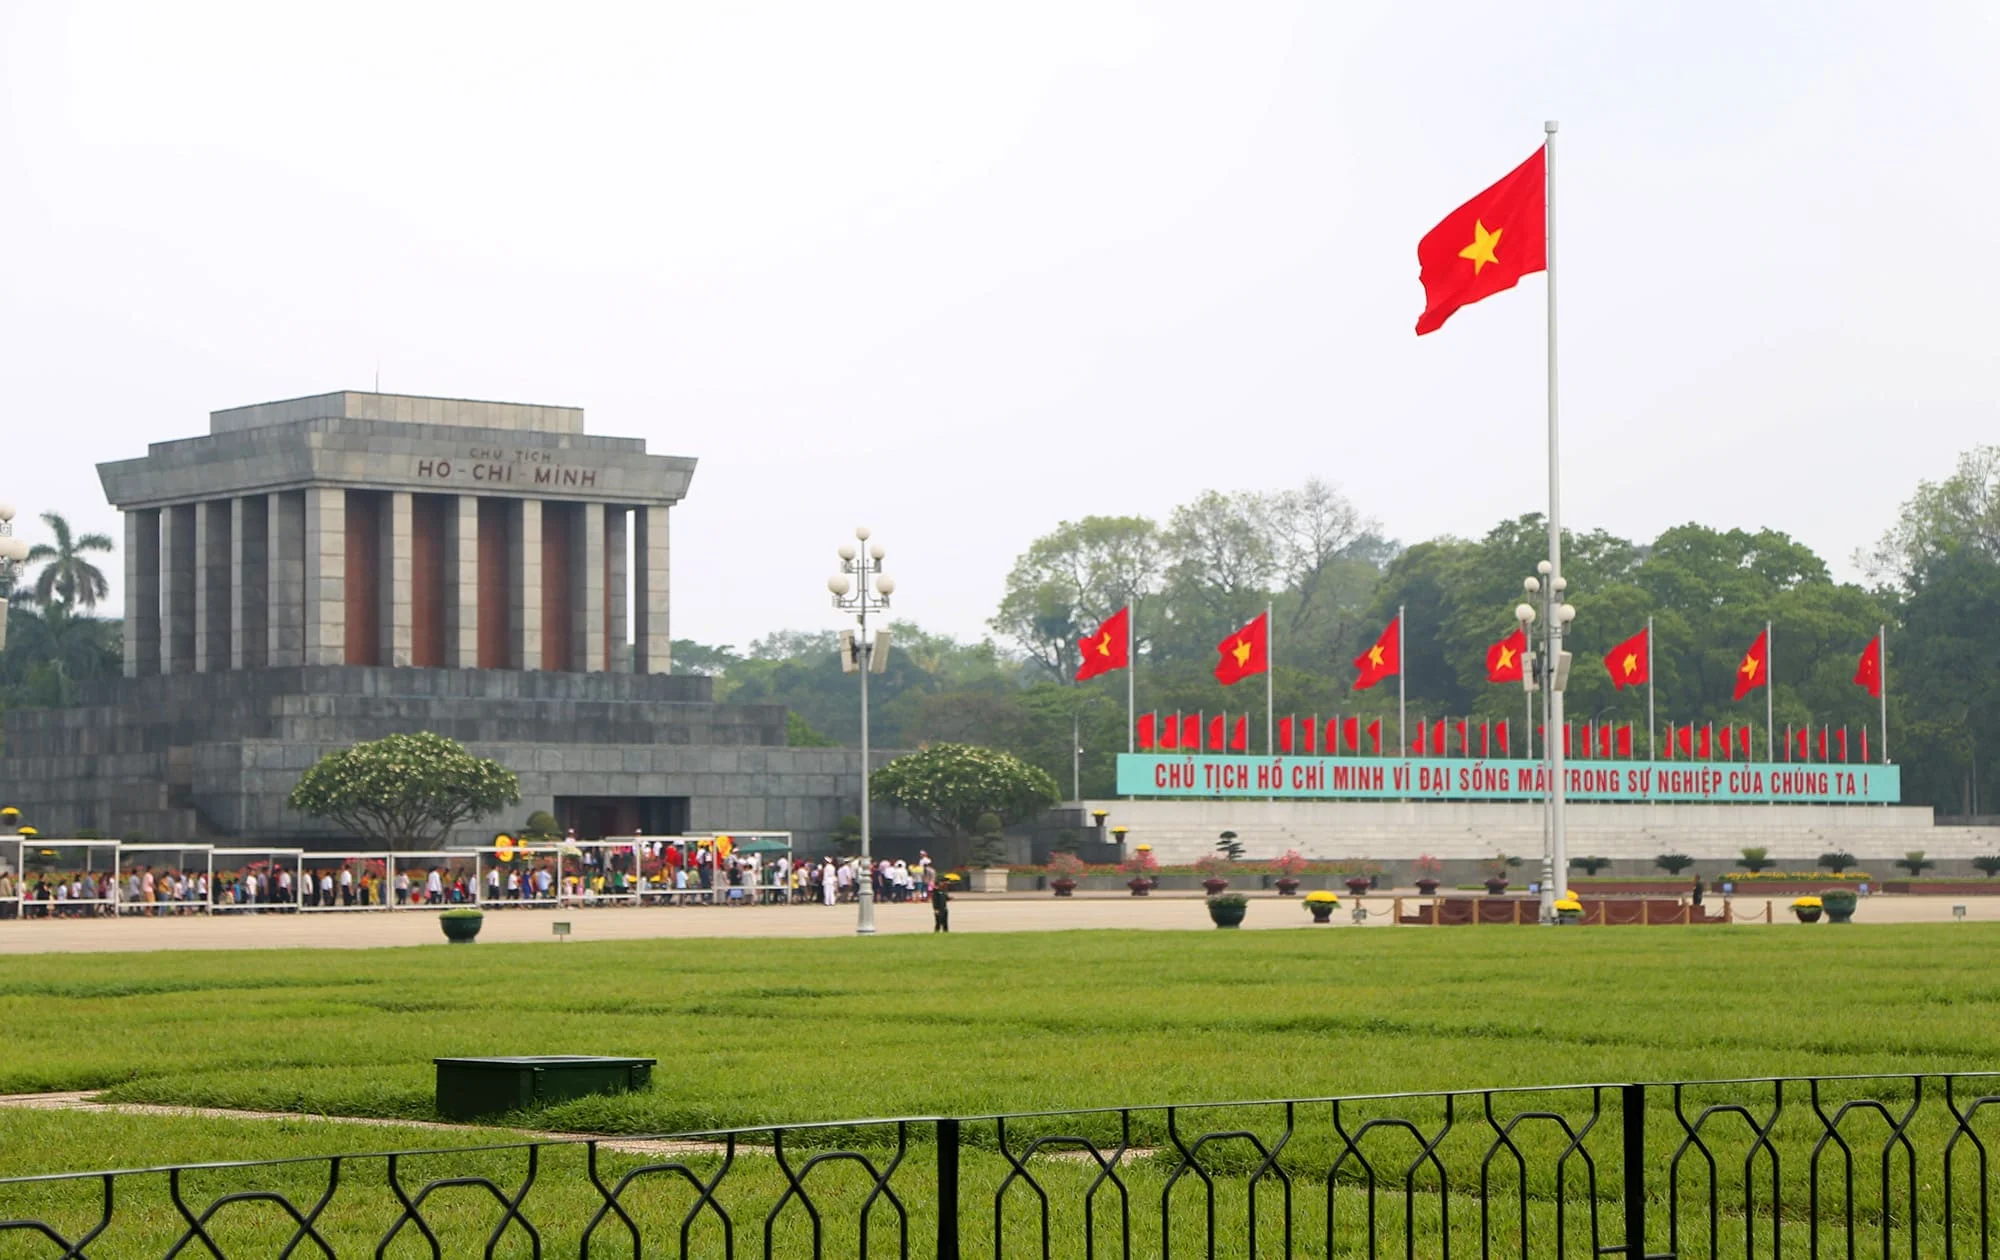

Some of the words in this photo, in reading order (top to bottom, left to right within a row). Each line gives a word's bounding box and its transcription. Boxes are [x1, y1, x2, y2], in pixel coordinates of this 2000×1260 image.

[1155, 756, 1195, 788] CHỦ
[1204, 764, 1248, 793] TỊCH
[1292, 761, 1324, 790] CHÍ
[1333, 766, 1384, 790] MINH
[1393, 762, 1411, 790] VĨ
[1419, 766, 1451, 795] ĐẠI
[1459, 761, 1509, 791] SỐNG
[1628, 768, 1652, 797] SỰ
[1658, 766, 1722, 797] NGHIỆP
[1729, 764, 1763, 794] CỦA
[1771, 768, 1828, 795] CHÚNG
[1835, 772, 1856, 795] TA
